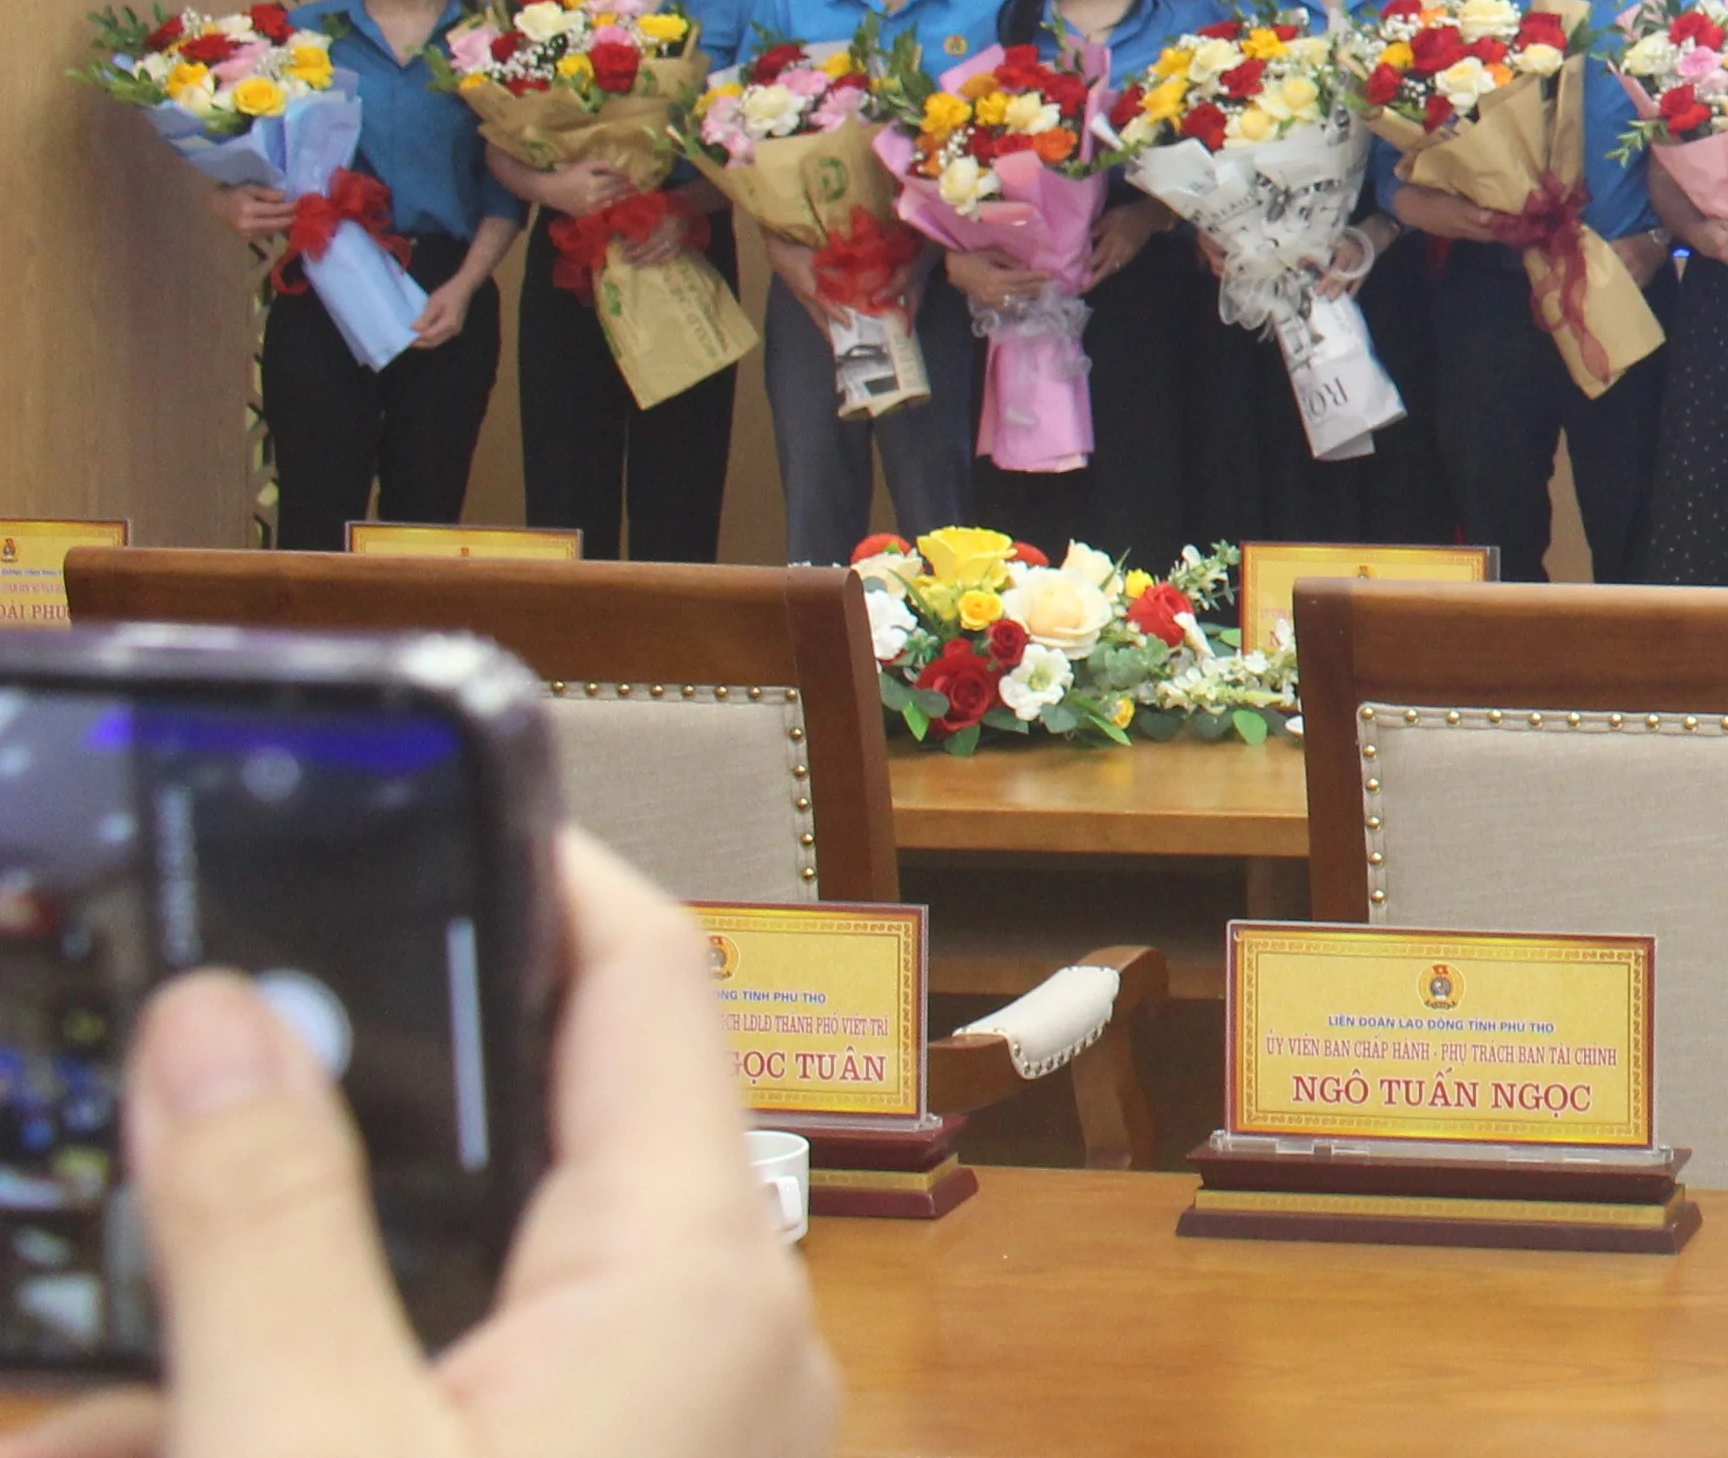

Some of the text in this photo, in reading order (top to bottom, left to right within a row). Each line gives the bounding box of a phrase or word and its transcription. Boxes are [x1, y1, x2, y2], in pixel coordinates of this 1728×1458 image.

[1328, 1014, 1355, 1027] LIÊN
[1399, 1018, 1423, 1029] LAO
[795, 1045, 886, 1082] TUÂN
[1288, 1033, 1320, 1056] VIÊN
[1324, 1039, 1351, 1057] BAN
[1354, 1032, 1388, 1059] CHẤP
[1392, 1037, 1430, 1060] HÀNH
[1441, 1043, 1467, 1066] PHỤ
[1472, 1040, 1514, 1063] TRÁCH
[1518, 1045, 1545, 1064] BAN
[1550, 1043, 1570, 1065] TÀI
[1575, 1043, 1617, 1066] CHÍNH
[1292, 1067, 1591, 1118] NGÔ TUẤN NGỌC
